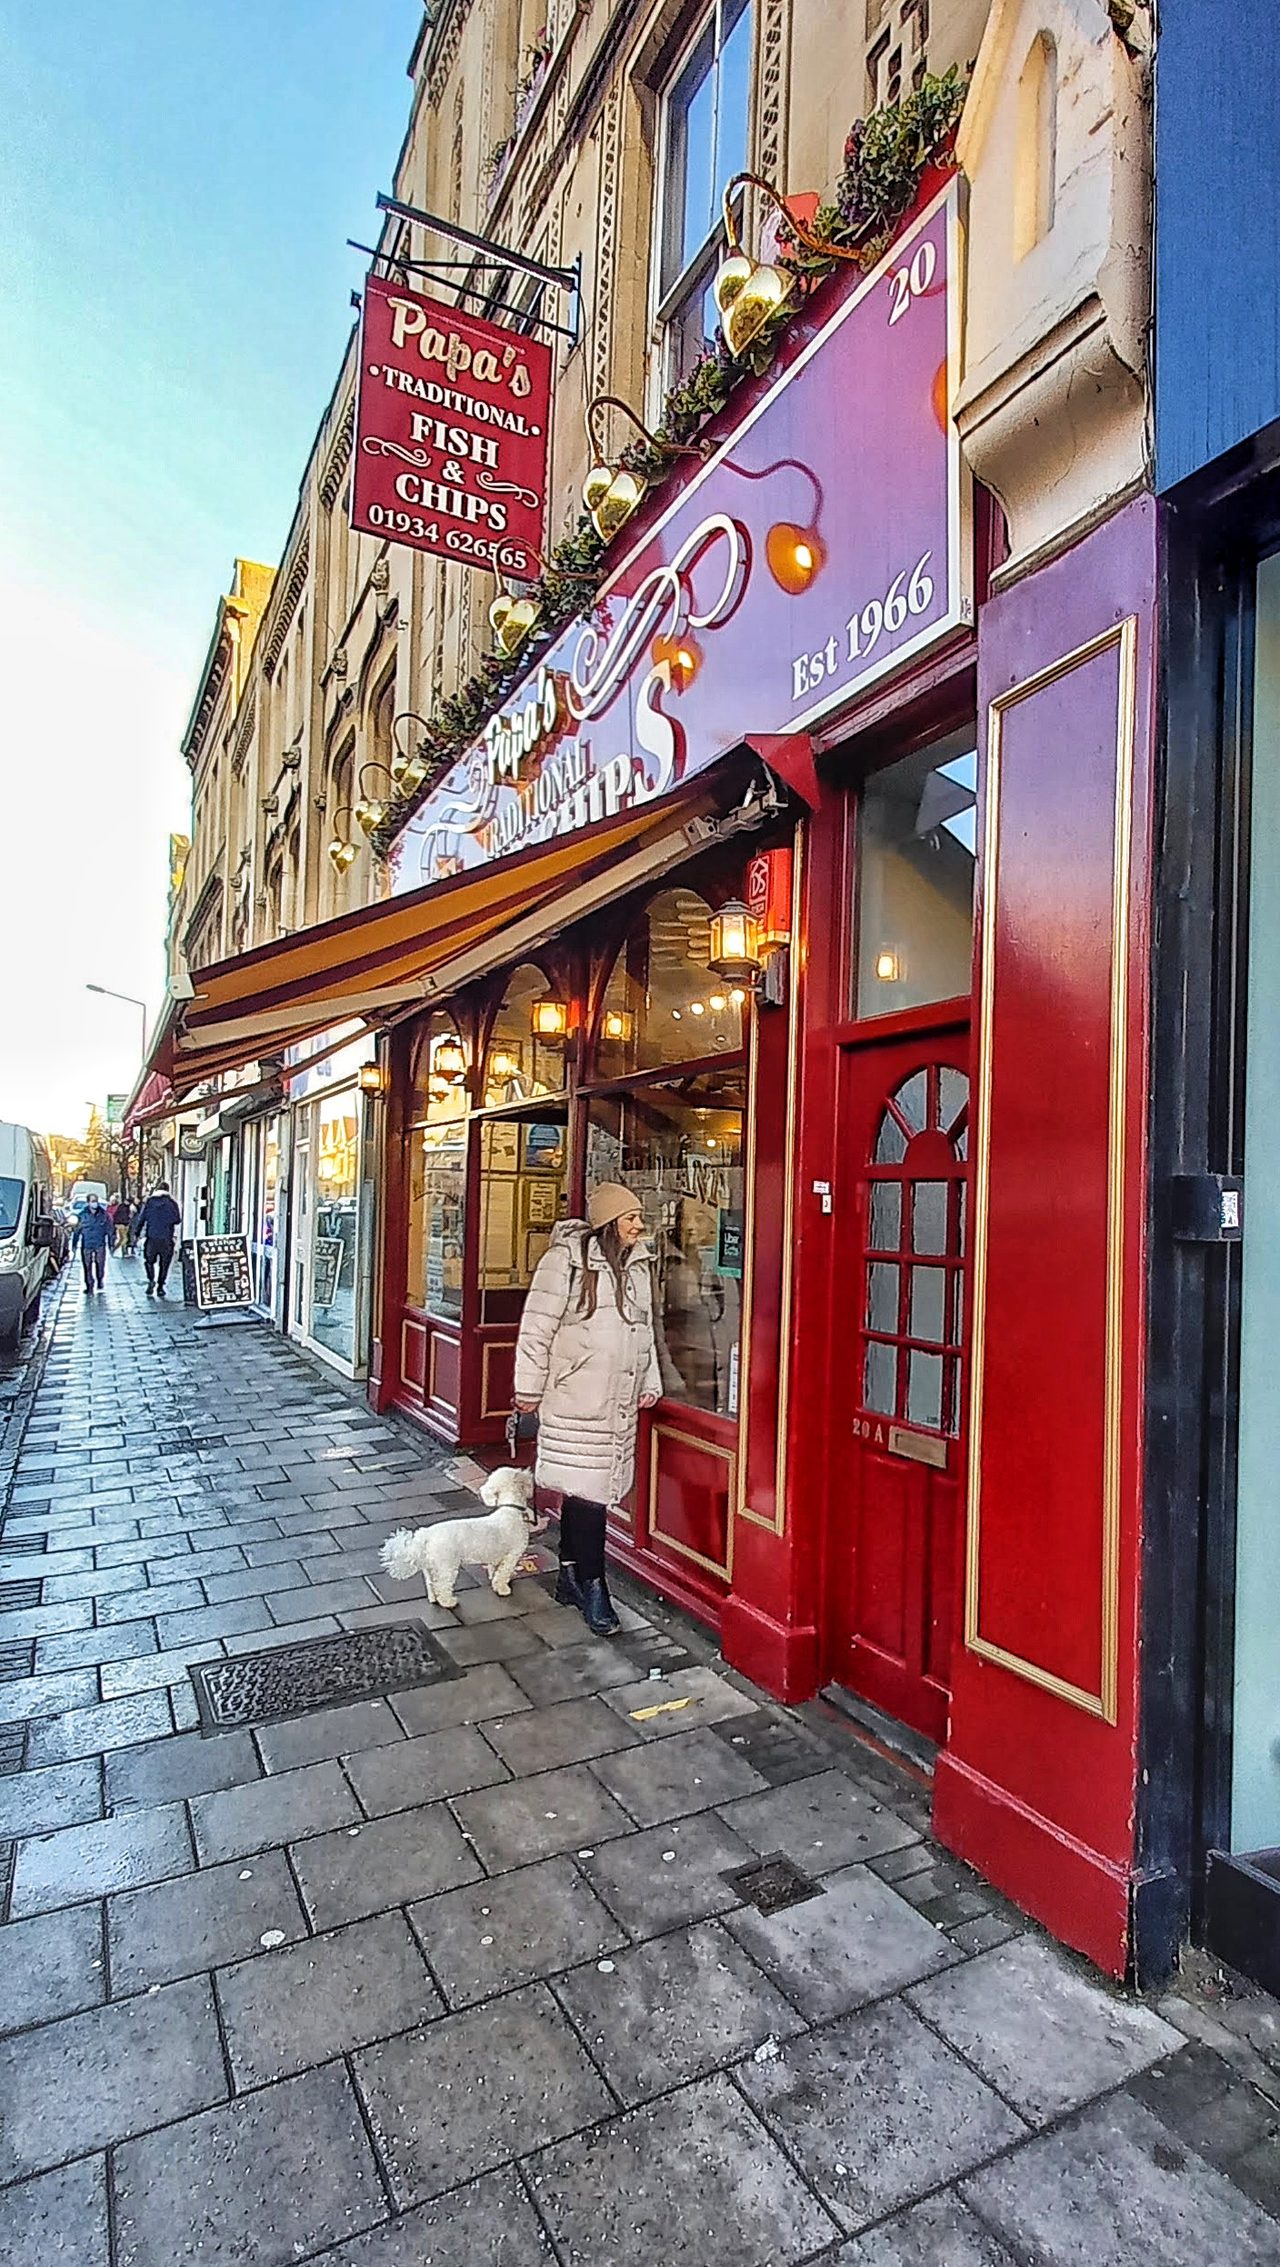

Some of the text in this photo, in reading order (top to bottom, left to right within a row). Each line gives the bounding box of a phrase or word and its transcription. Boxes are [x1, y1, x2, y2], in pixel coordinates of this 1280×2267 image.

[888, 241, 937, 326] 20
[387, 297, 532, 398] Papa's
[382, 364, 531, 437] TRADITIONAL
[410, 412, 500, 469] FISH
[442, 460, 466, 485] &
[368, 504, 528, 571] 01934 626565
[395, 473, 507, 531] CHIPS
[791, 550, 935, 700] Est 1966
[484, 666, 557, 785] Papa's
[481, 738, 591, 859] TRADITIONAL
